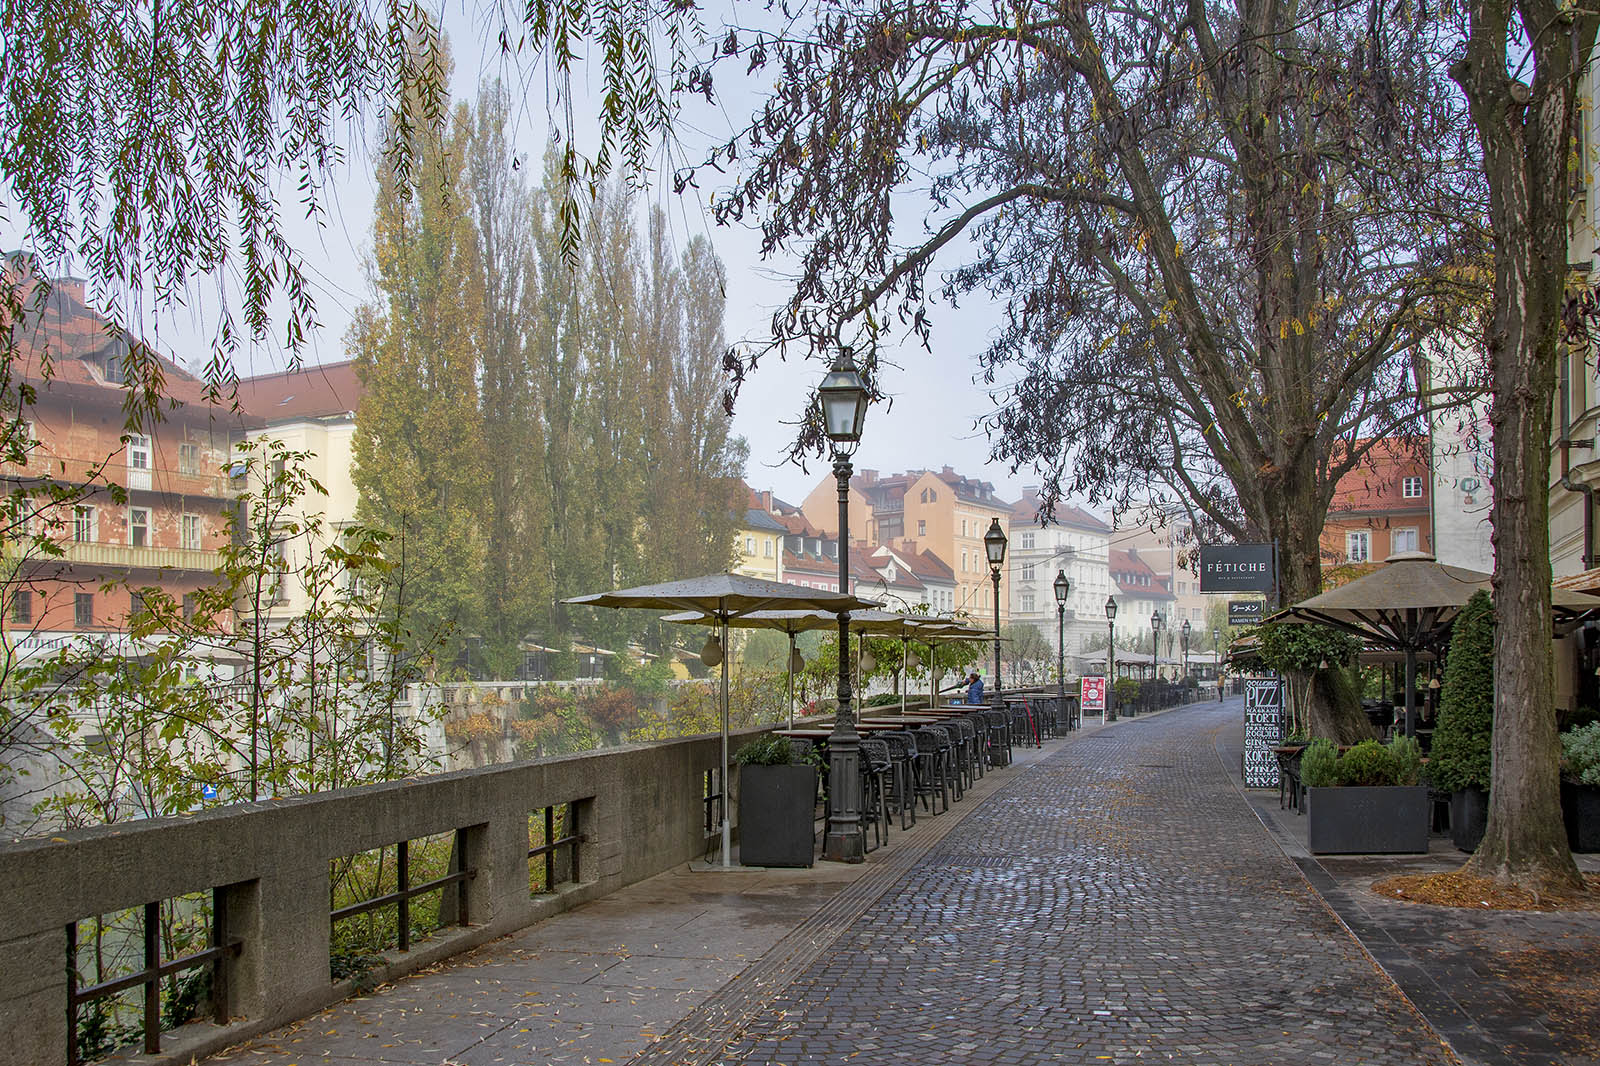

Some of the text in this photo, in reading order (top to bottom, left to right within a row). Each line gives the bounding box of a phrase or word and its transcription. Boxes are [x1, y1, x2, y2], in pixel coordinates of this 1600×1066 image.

[1207, 560, 1266, 572] FÉTICHE
[1232, 604, 1258, 612] ラーメン
[16, 638, 65, 649] PIZZERIA
